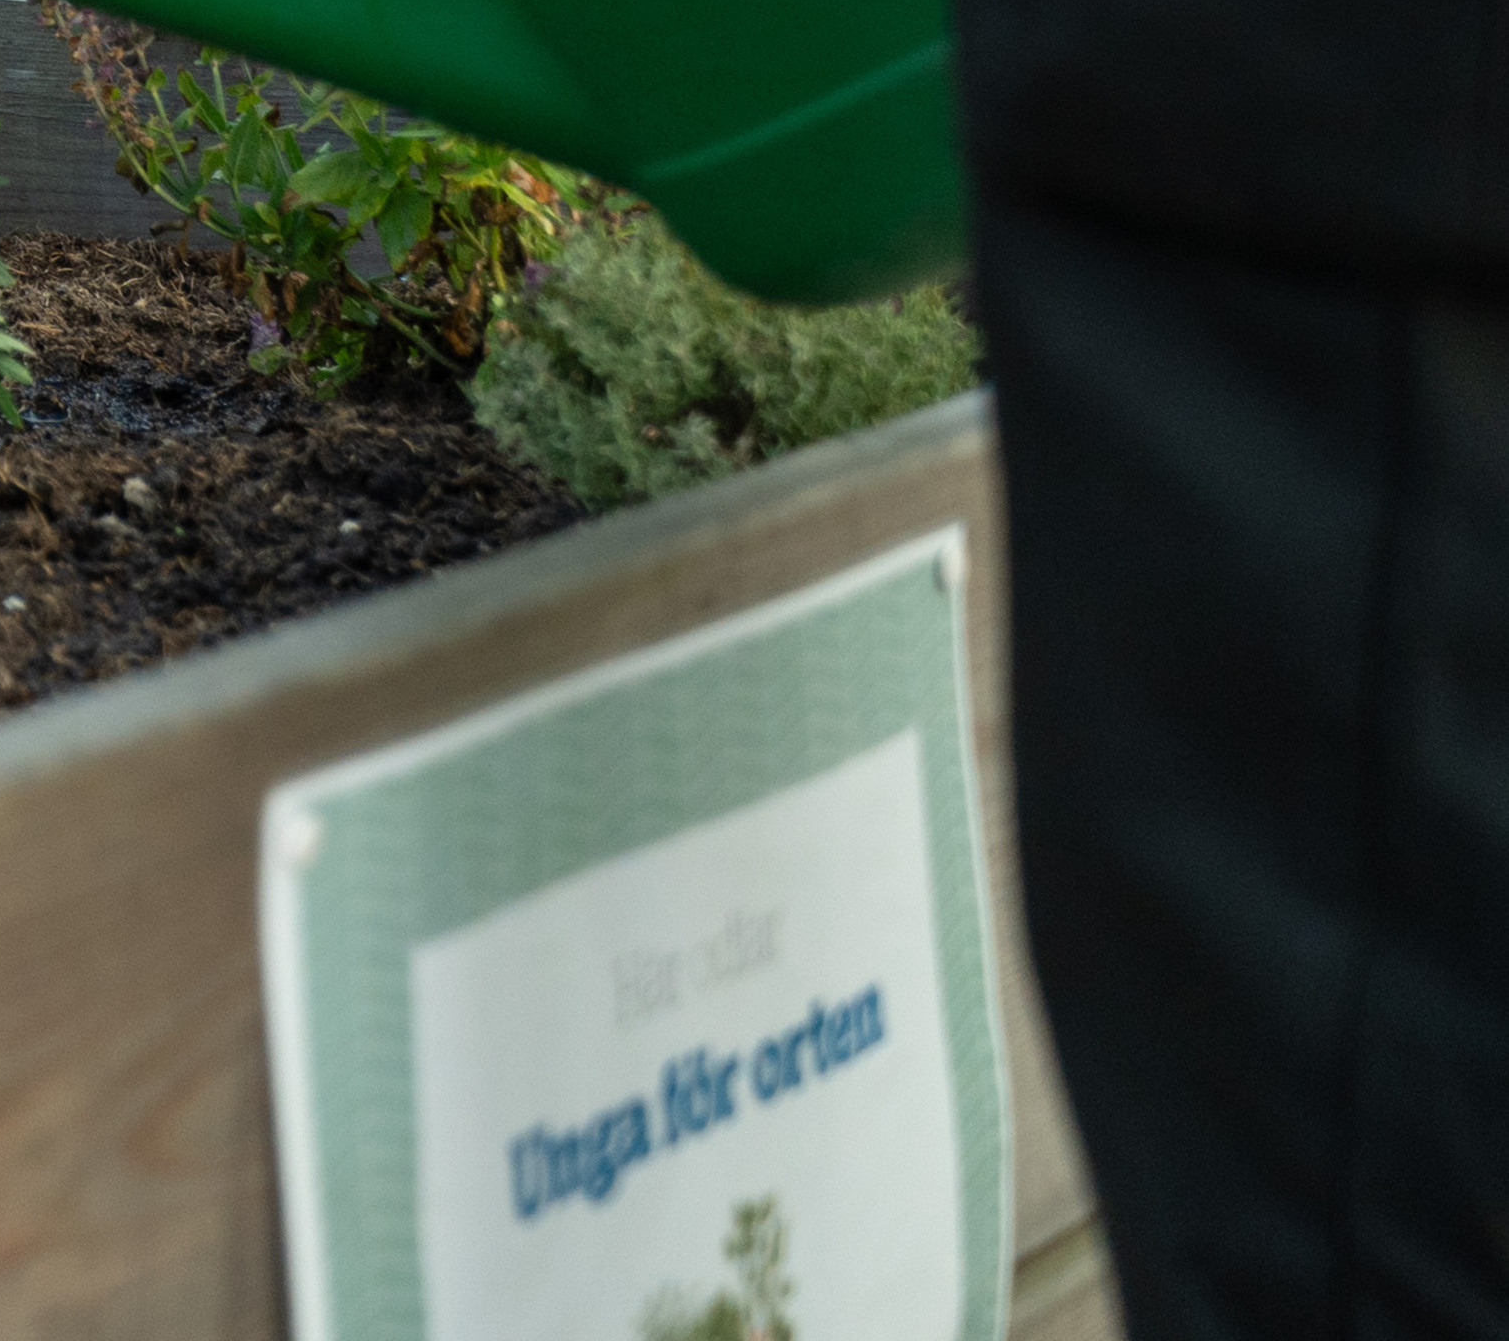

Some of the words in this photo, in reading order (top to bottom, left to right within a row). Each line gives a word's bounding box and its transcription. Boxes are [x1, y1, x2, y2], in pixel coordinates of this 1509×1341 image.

[510, 1097, 650, 1221] Unga
[662, 1047, 740, 1148] för
[752, 981, 886, 1102] orten
